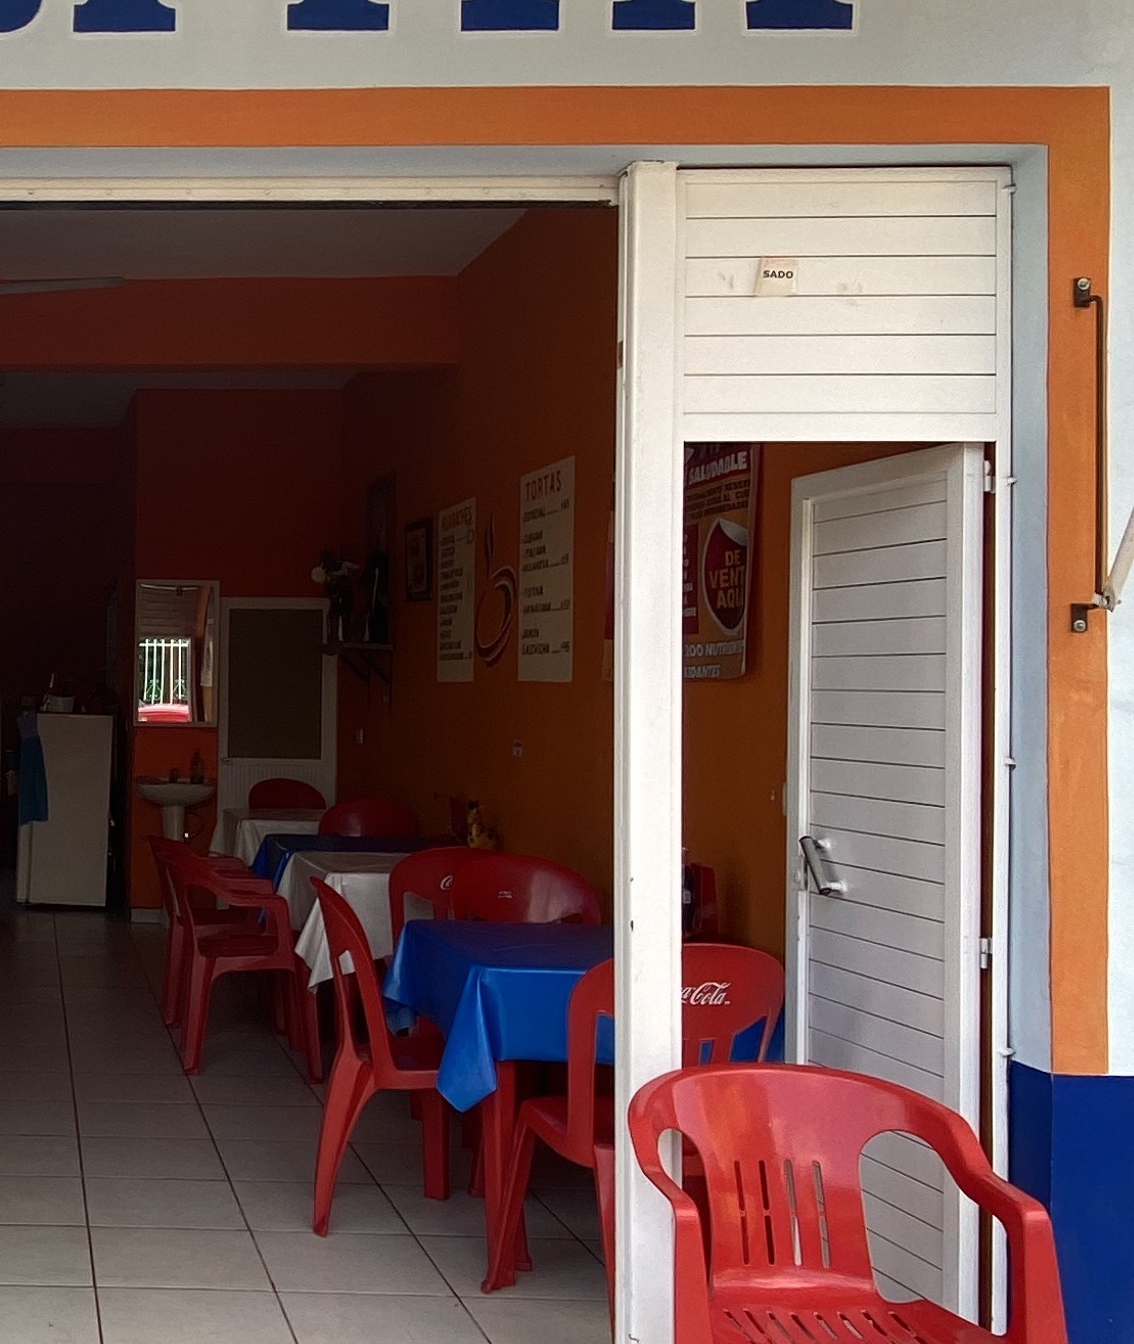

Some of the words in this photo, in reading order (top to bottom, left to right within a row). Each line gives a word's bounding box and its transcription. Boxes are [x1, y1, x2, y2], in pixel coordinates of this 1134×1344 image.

[763, 269, 794, 279] SADO
[525, 470, 562, 502] TORTAS
[724, 549, 741, 566] DE
[708, 565, 745, 589] VENT
